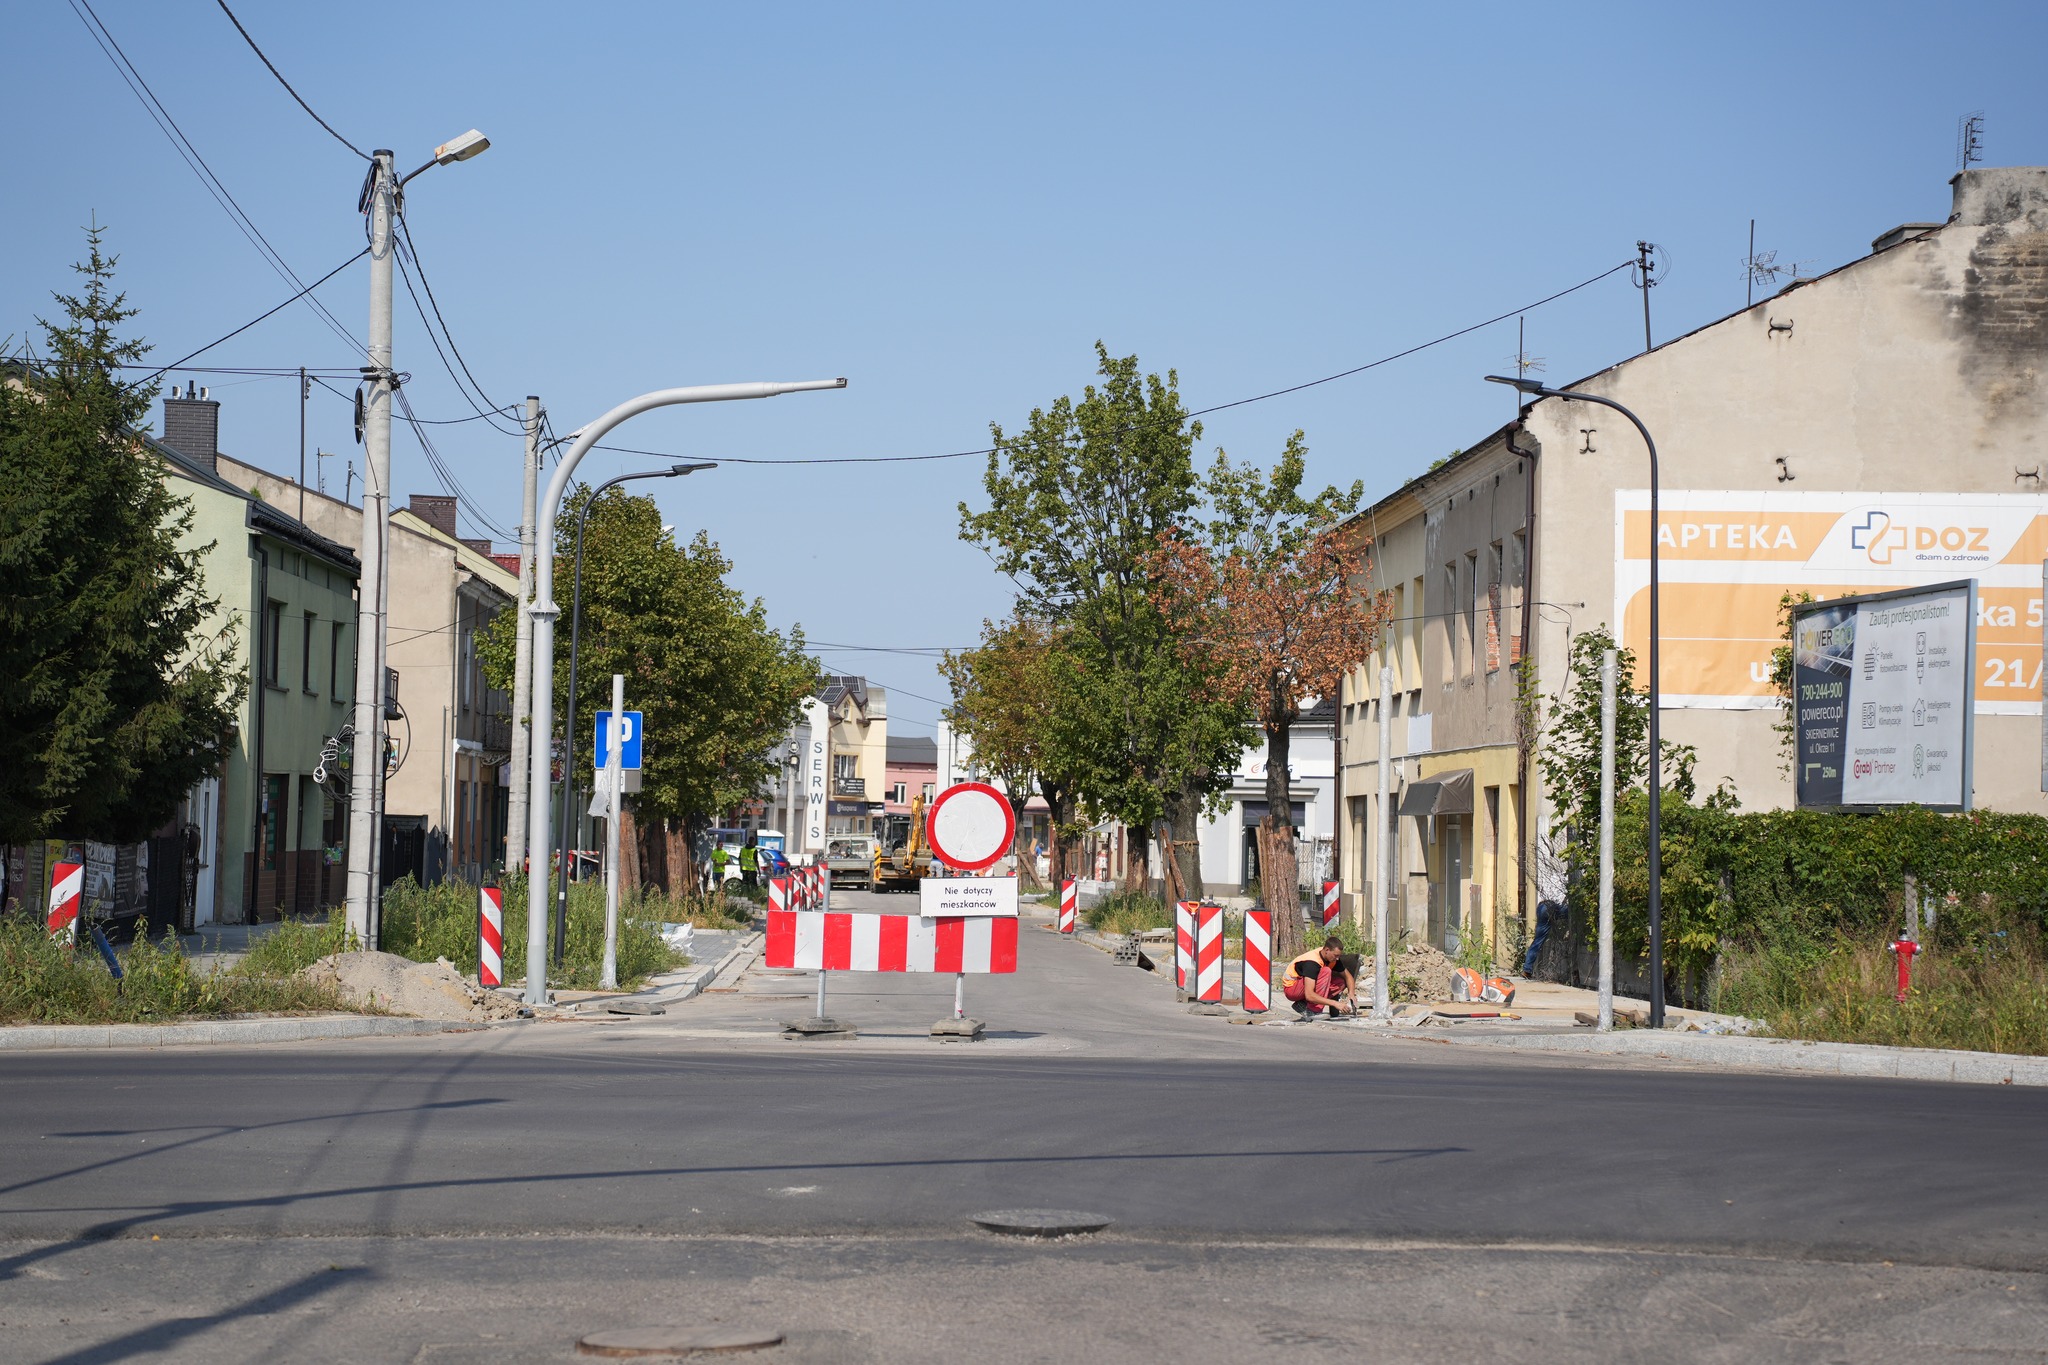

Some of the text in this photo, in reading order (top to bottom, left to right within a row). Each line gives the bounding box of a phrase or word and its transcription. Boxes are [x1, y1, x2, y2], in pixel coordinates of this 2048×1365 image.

[1657, 523, 1797, 549] APTEKA
[1915, 526, 1990, 552] DOZ
[1915, 553, 1942, 561] dbam
[1868, 602, 1950, 628] Zaufaj profesjonalistom!
[1801, 682, 1843, 701] 790-244-900
[1801, 701, 1844, 725] powereco.pl
[605, 716, 633, 752] P
[1805, 727, 1840, 740] SKIERNIEWICE
[1822, 766, 1837, 778] 250m
[1874, 760, 1896, 774] Partner
[810, 742, 824, 839] SERWIS
[944, 886, 993, 896] Nie dotyczy
[940, 899, 996, 909] mieszkańców
